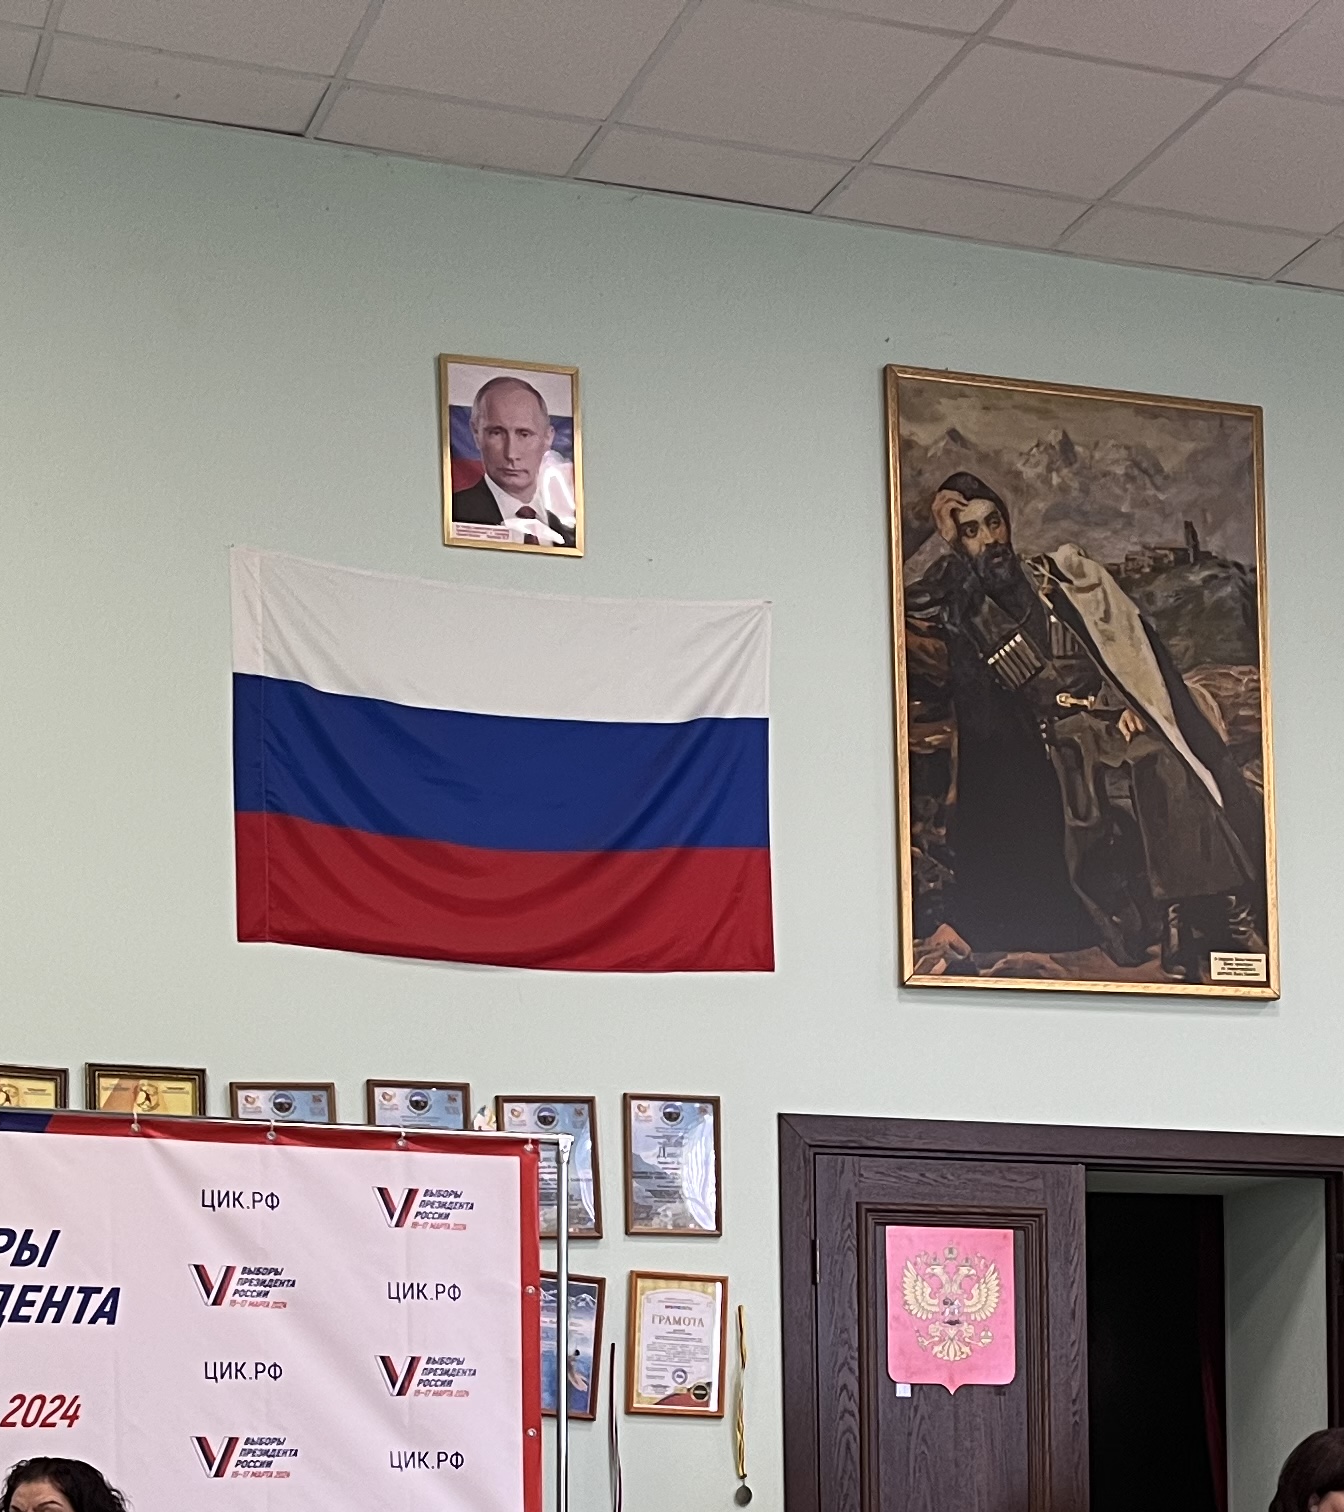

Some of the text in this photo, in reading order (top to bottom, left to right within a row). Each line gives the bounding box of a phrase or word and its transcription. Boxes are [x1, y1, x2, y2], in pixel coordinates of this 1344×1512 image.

[423, 1188, 463, 1199] ВЫБОРЫ
[201, 1189, 280, 1211] ЦИК.РФ
[418, 1200, 474, 1211] ПРЕЗИДЕНТА
[414, 1211, 450, 1220] РОССИИ
[241, 1266, 284, 1276] ВЫБОРЫ
[236, 1277, 296, 1289] ПРЕЗИДЕНТА
[232, 1288, 270, 1299] РОССИИ
[387, 1281, 461, 1304] ЦИК.РФ
[652, 1314, 705, 1328] ГРАМОТА
[425, 1356, 465, 1366] ВЫБОРЫ
[204, 1361, 283, 1383] ЦИК.РФ
[421, 1367, 477, 1378] ПРЕЗИДЕНТА
[417, 1379, 453, 1388] РОССИИ
[0, 1394, 81, 1428] 2024
[243, 1437, 286, 1447] ВЫБОРЫ
[239, 1448, 299, 1459] ПРЕЗИДЕНТА
[235, 1459, 273, 1469] РОССИИ
[390, 1451, 464, 1472] ЦИК.РФ
